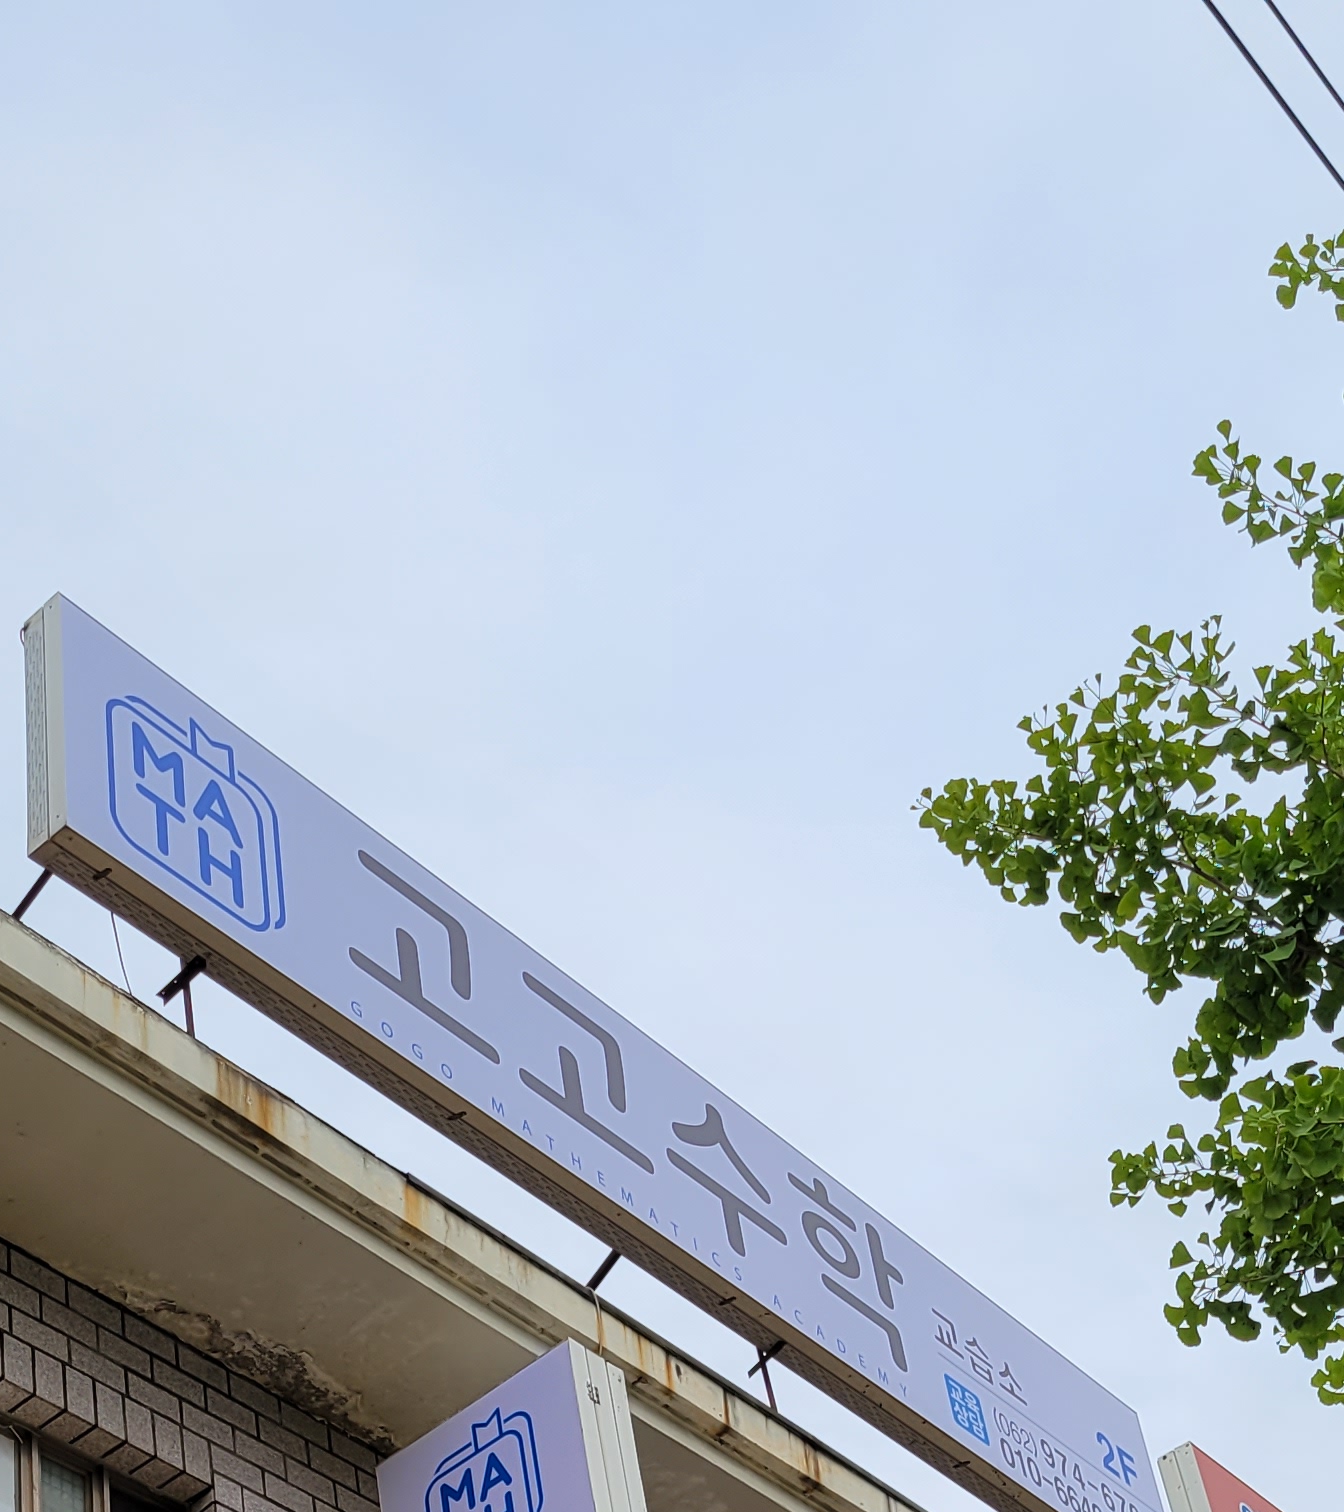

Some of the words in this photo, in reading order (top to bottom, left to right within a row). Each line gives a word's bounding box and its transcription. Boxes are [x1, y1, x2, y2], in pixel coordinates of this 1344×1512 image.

[348, 849, 909, 1372] 고고수학
[351, 1001, 453, 1080] GOGO
[491, 1096, 743, 1282] MATHEMATICS
[772, 1294, 909, 1397] ACADEMY
[932, 1307, 1028, 1406] 교습소
[1096, 1431, 1138, 1487] 2F
